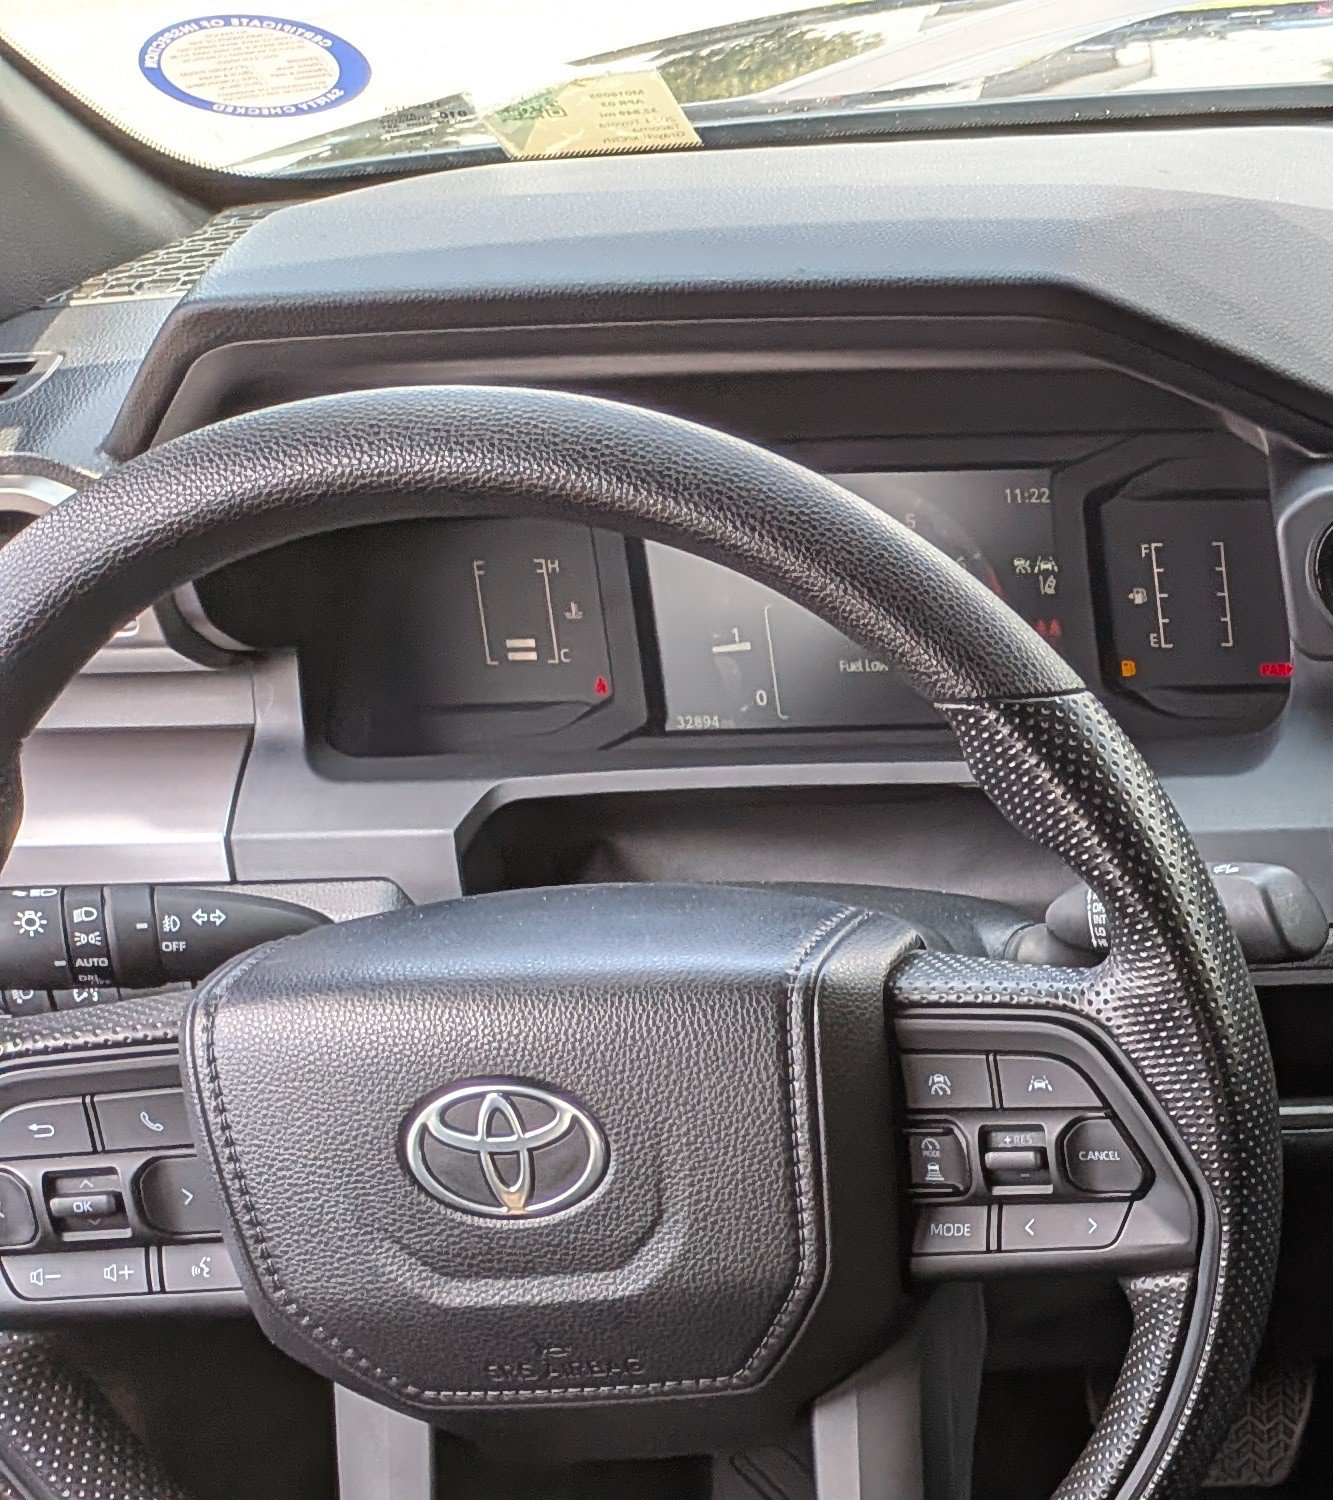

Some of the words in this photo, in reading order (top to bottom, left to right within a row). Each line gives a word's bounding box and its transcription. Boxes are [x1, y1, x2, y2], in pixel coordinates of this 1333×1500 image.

[1005, 487, 1051, 504] 11:22
[560, 649, 571, 663] C
[676, 714, 719, 729] 32894
[161, 941, 187, 952] OFF
[75, 957, 109, 967] AUTO
[1078, 1150, 1121, 1161] CANCEL
[73, 1201, 93, 1213] OK
[930, 1222, 971, 1237] MODE
